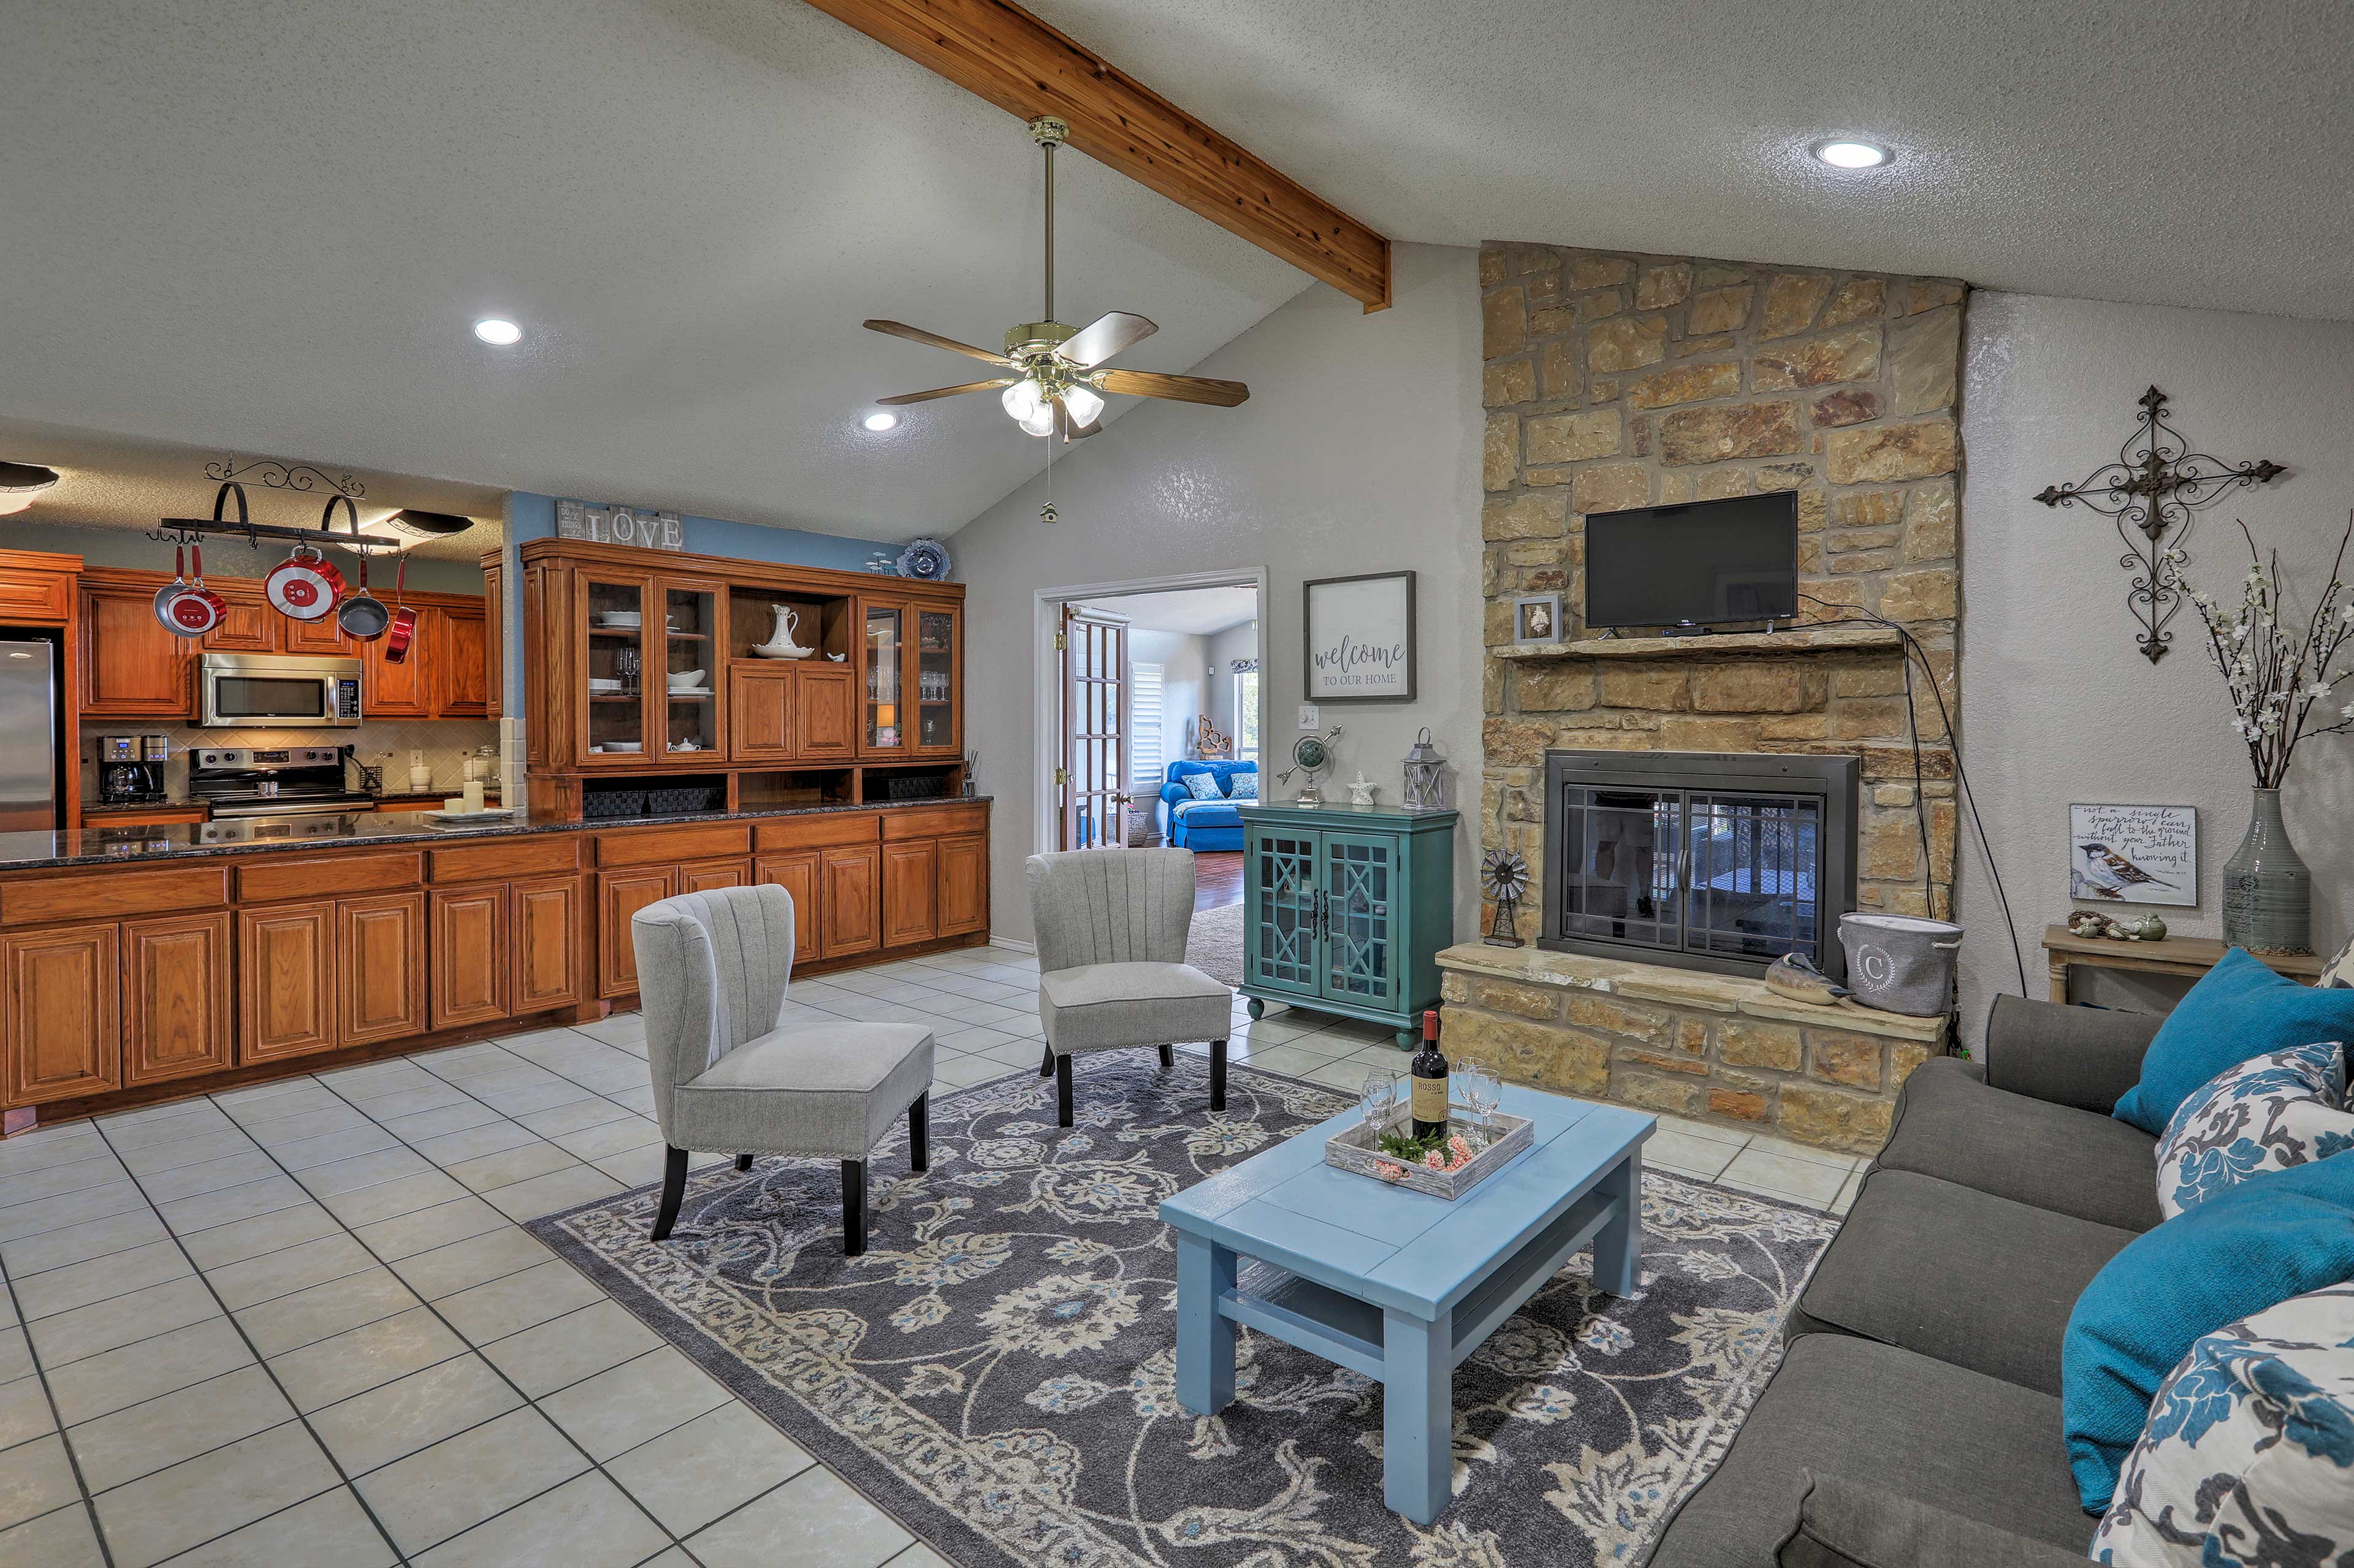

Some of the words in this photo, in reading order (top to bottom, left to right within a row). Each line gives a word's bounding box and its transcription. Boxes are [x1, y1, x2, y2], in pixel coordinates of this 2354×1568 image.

[561, 520, 581, 529] THINGS
[588, 513, 682, 548] LOVE
[1315, 634, 1406, 673] welcome
[1323, 676, 1337, 686] TO
[1340, 676, 1362, 685] OUR
[1365, 673, 1397, 684] HOME
[2088, 815, 2154, 829] sparrow
[2129, 808, 2181, 825] single
[2101, 823, 2124, 835] fall
[2127, 824, 2139, 833] to
[2140, 825, 2156, 835] the
[2158, 823, 2193, 837] ground
[2073, 831, 2117, 843] without
[2122, 837, 2145, 850] your
[2144, 834, 2191, 849] Father
[2131, 847, 2177, 868] knowing
[1865, 956, 1884, 980] C
[1418, 1083, 1441, 1091] ROSSO
